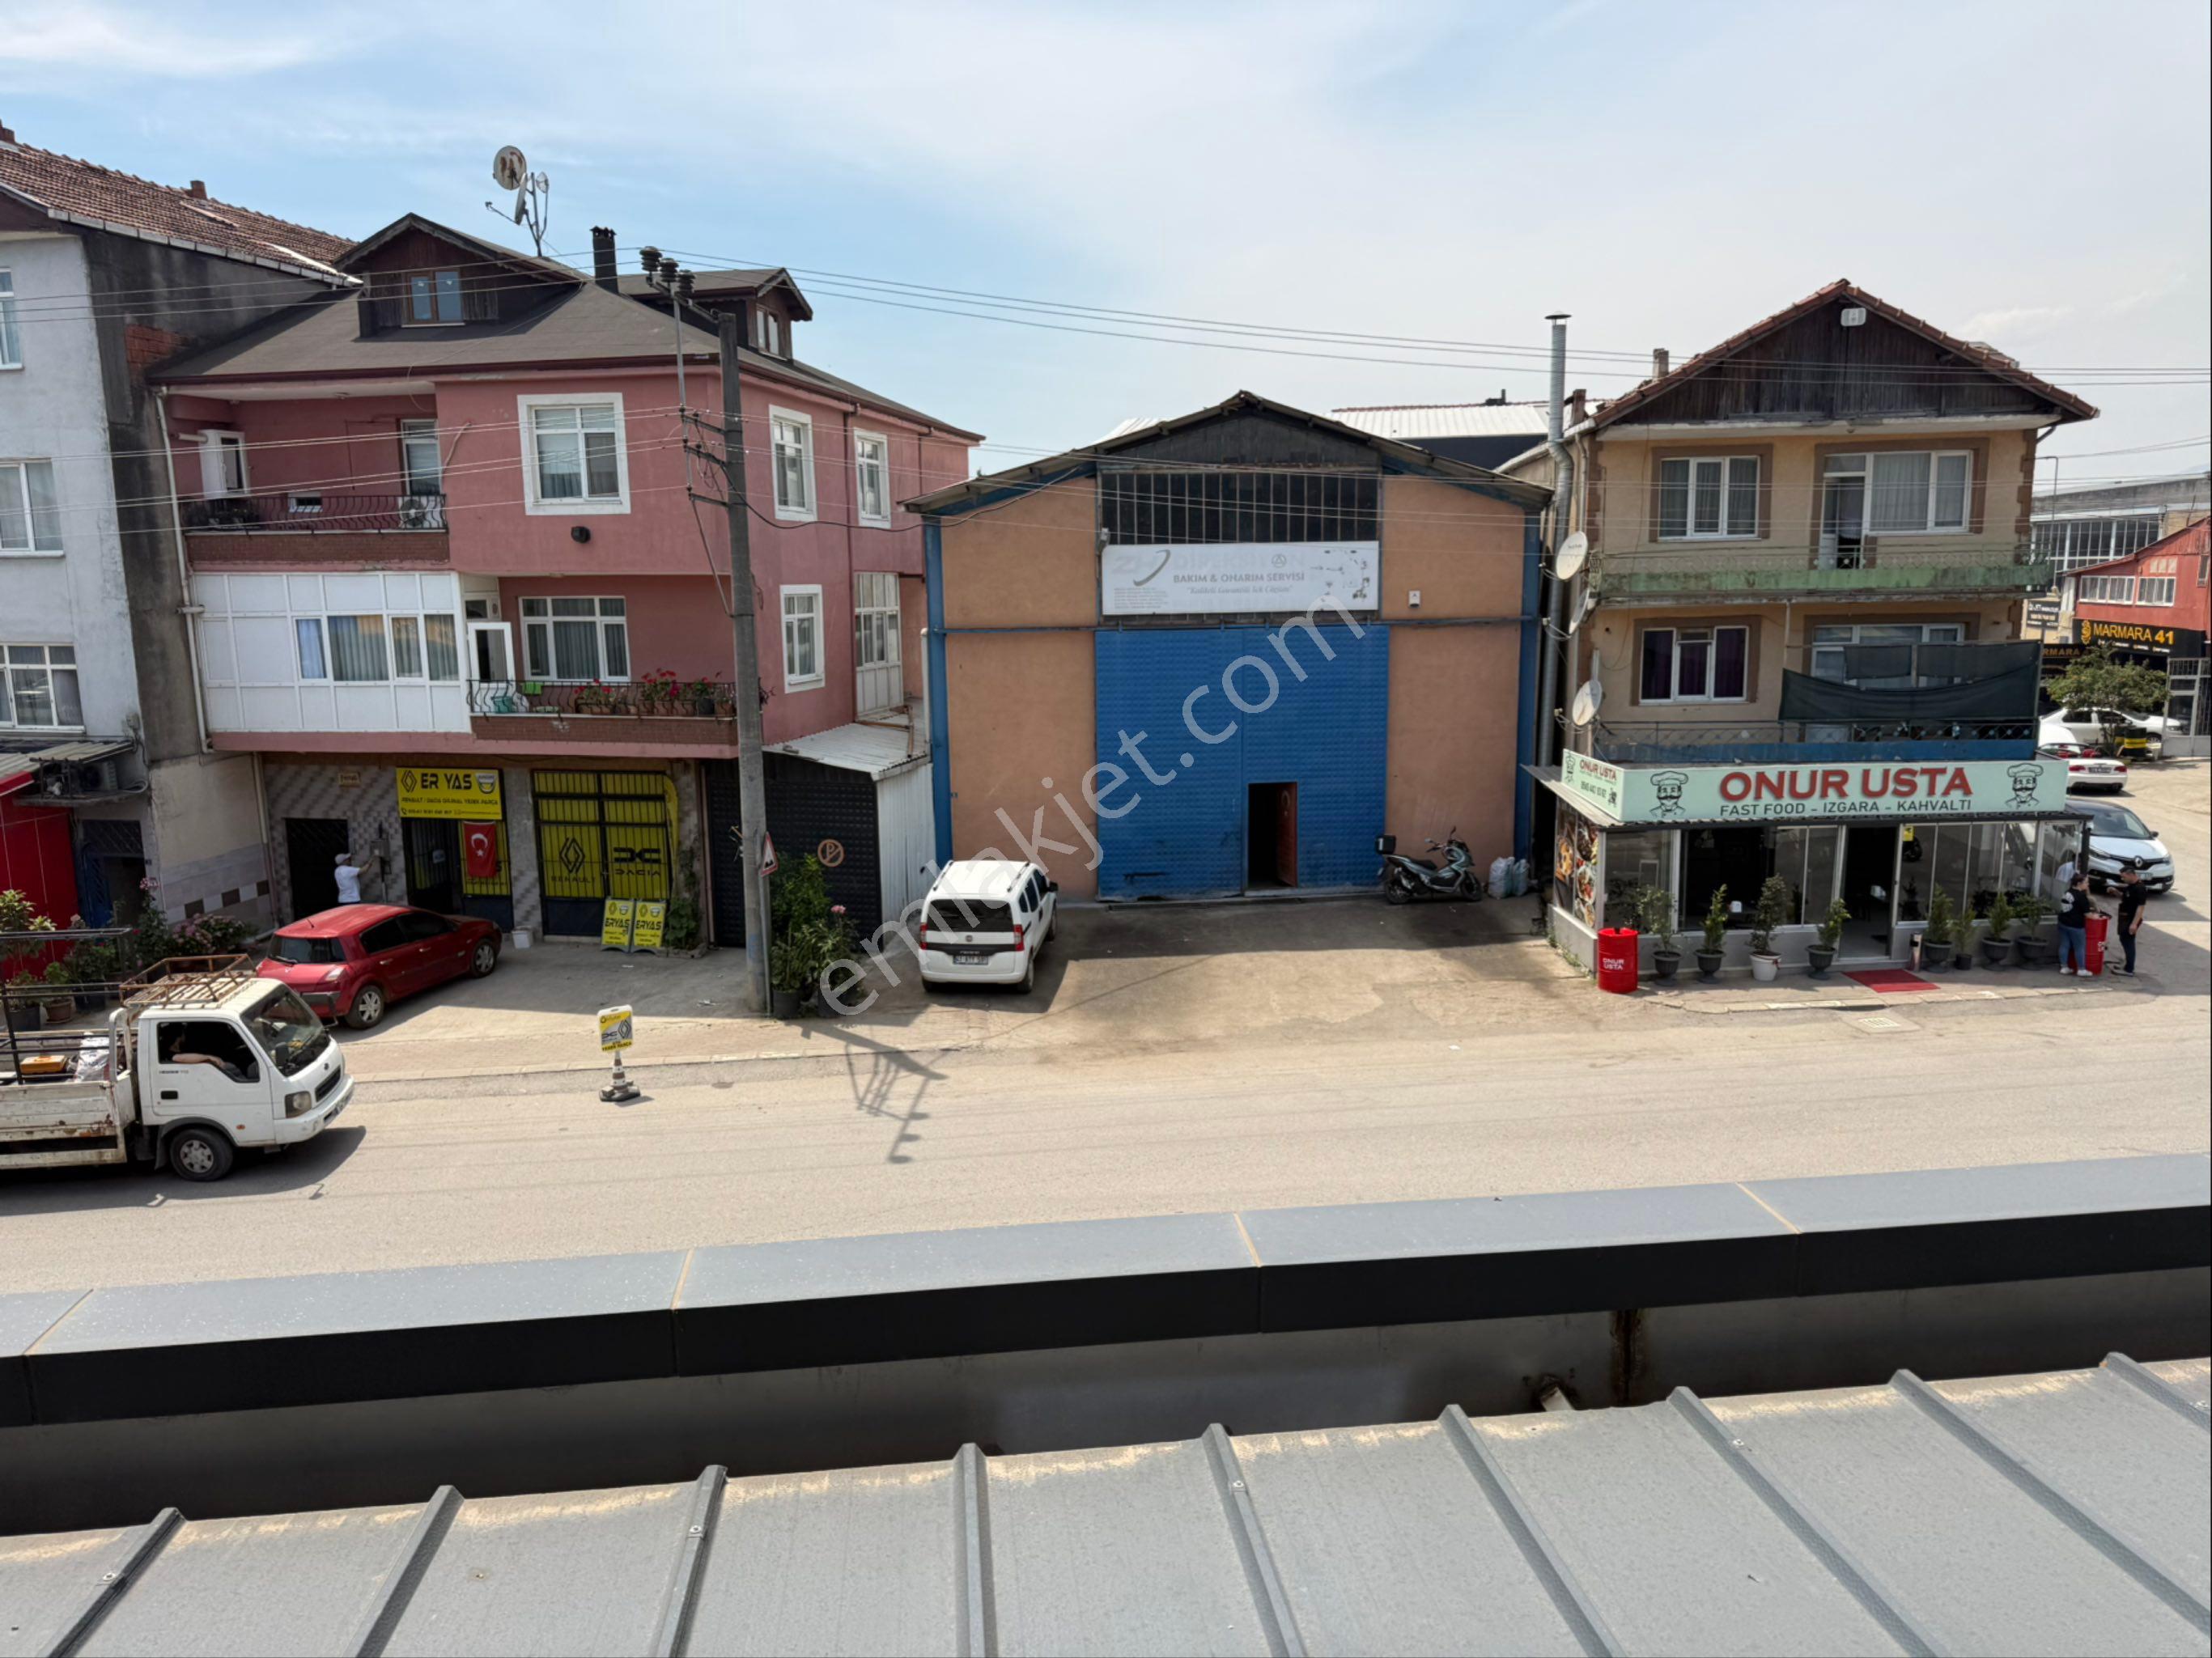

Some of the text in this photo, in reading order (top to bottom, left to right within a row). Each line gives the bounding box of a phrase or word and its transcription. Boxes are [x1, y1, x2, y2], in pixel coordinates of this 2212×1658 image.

[1174, 571, 1305, 583] BAKIM & ONARIM SERVİSİ
[2094, 622, 2174, 645] MARMARA 41
[1580, 759, 1598, 774] ONUR
[1599, 765, 1616, 781] USTA
[421, 773, 472, 791] ER YAS
[1720, 767, 1972, 801] ONUR USTA
[1721, 804, 1760, 816] FAST
[1764, 803, 1806, 815] FOOD
[1824, 801, 1879, 813] IZGARA
[1897, 799, 1971, 812] KAHVALTI
[605, 918, 630, 928] ERYAS
[635, 920, 662, 931] ERYAS
